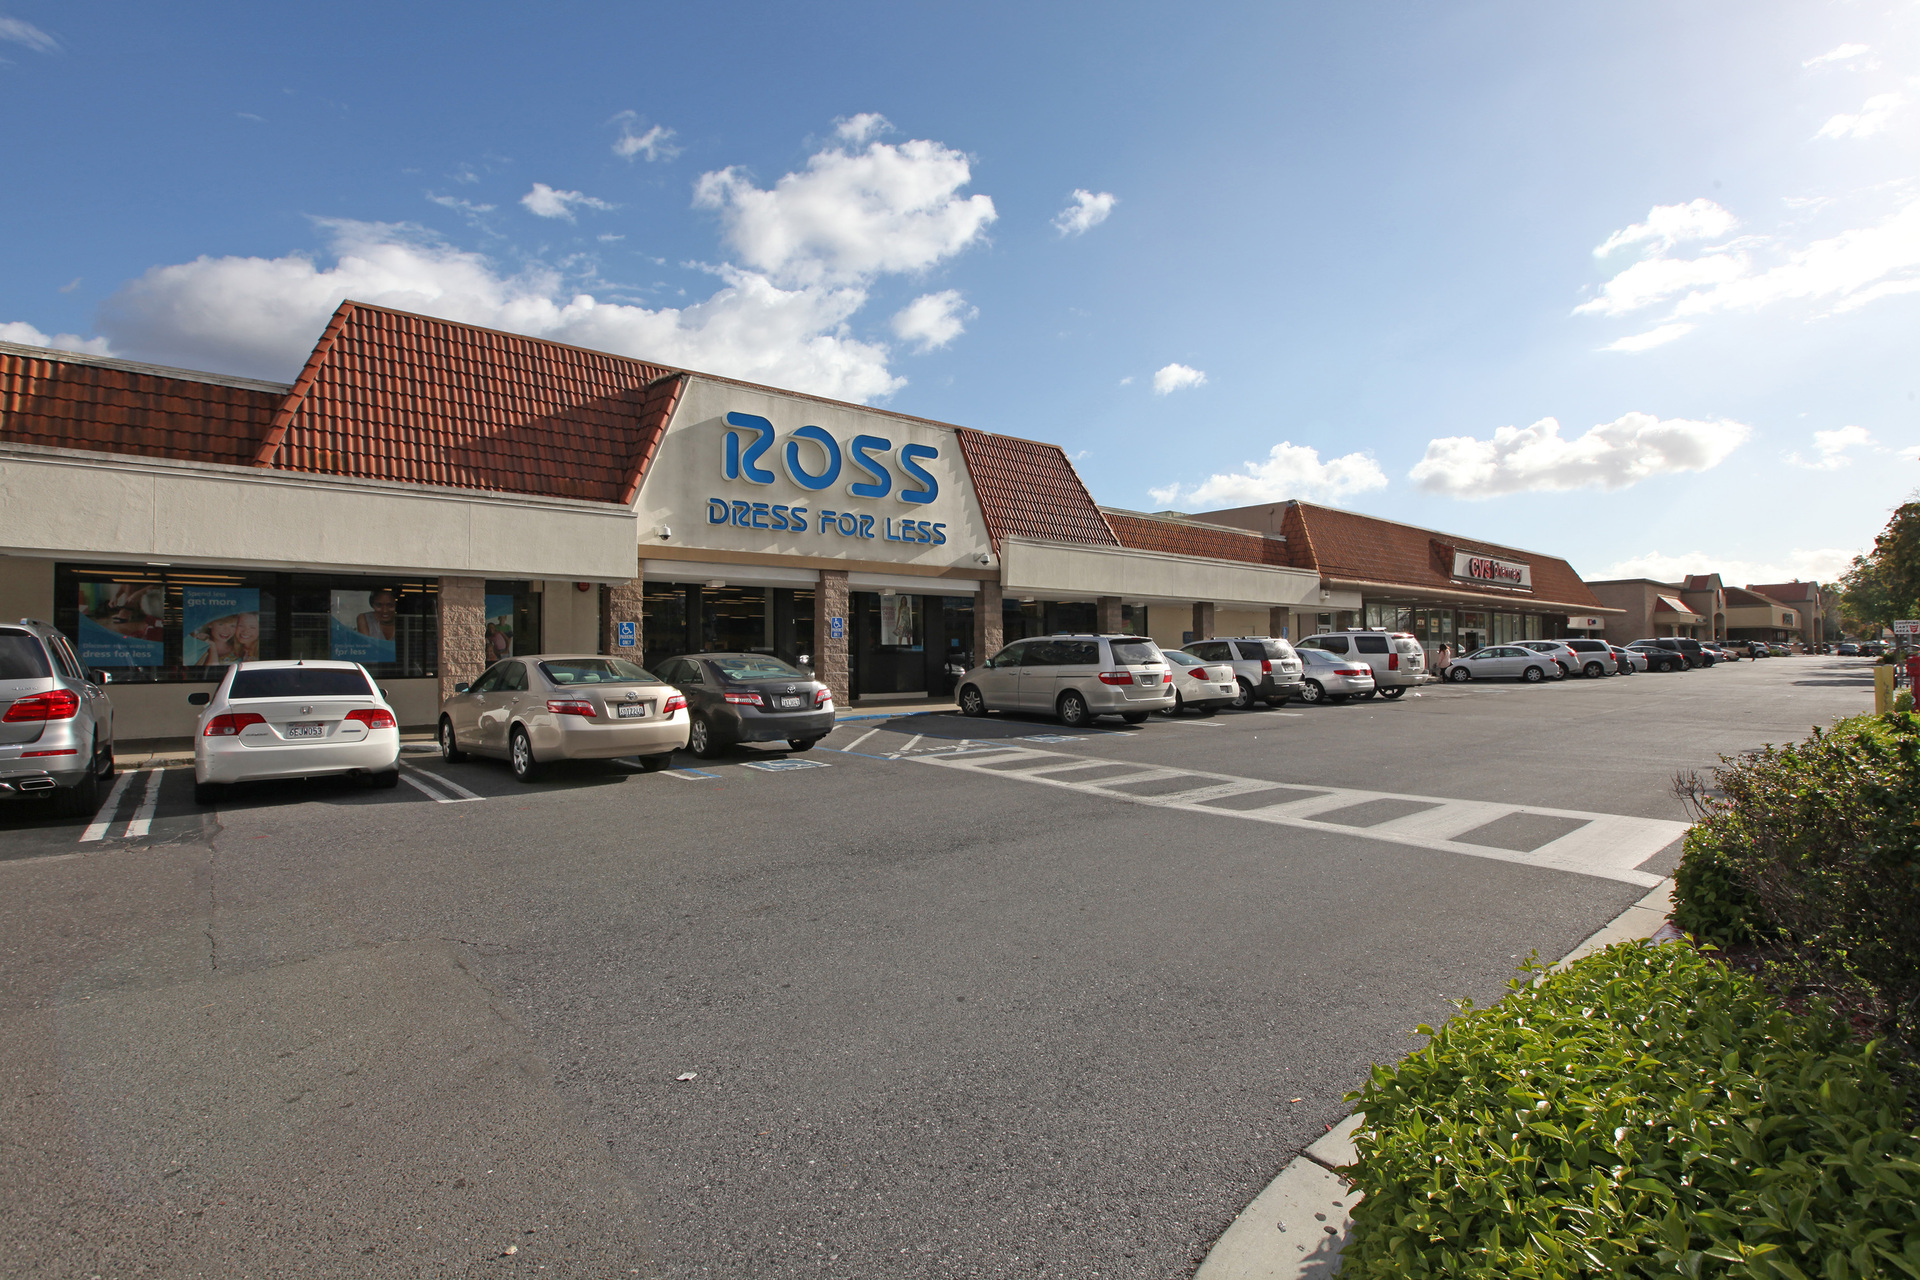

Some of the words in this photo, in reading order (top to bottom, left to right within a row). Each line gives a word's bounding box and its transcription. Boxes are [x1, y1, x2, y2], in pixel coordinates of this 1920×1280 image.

[722, 411, 939, 504] ROSS
[706, 497, 808, 533] DRESS
[818, 510, 875, 539] FOR
[884, 517, 947, 545] LESS
[187, 598, 207, 607] get
[82, 650, 111, 658] dress
[114, 650, 129, 658] for
[132, 650, 152, 658] less
[289, 726, 323, 737] 6EJW053
